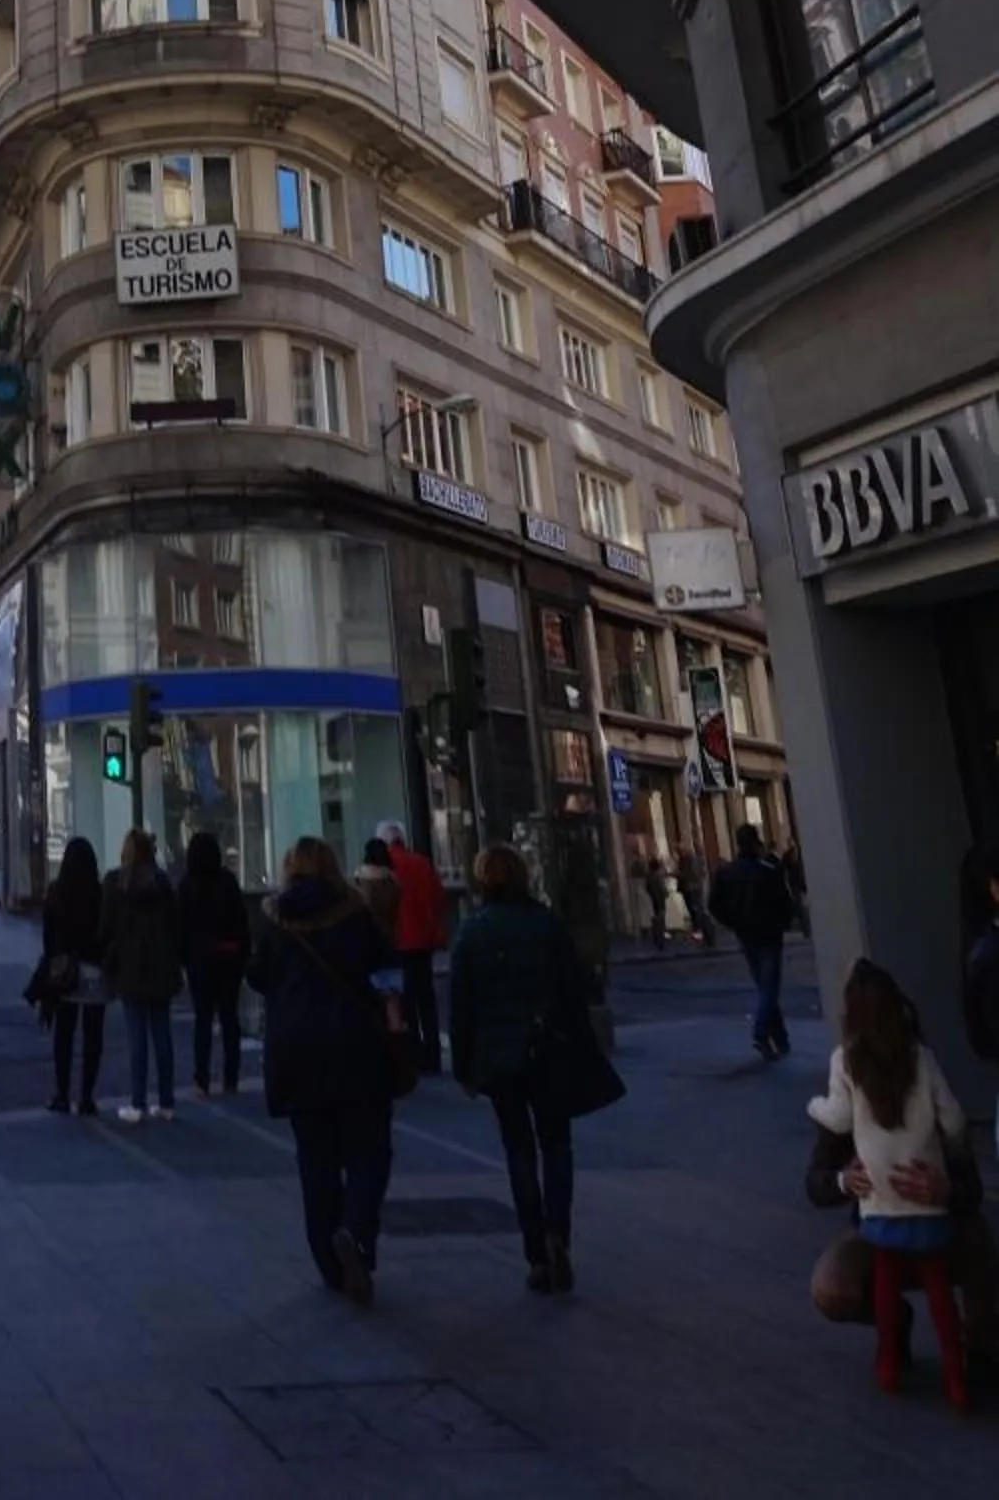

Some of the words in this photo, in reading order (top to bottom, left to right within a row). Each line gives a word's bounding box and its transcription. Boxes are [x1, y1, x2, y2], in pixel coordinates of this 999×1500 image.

[120, 229, 232, 260] ESCUELA
[166, 256, 186, 273] DE
[125, 269, 232, 298] TURISMO
[800, 428, 969, 558] BBVA
